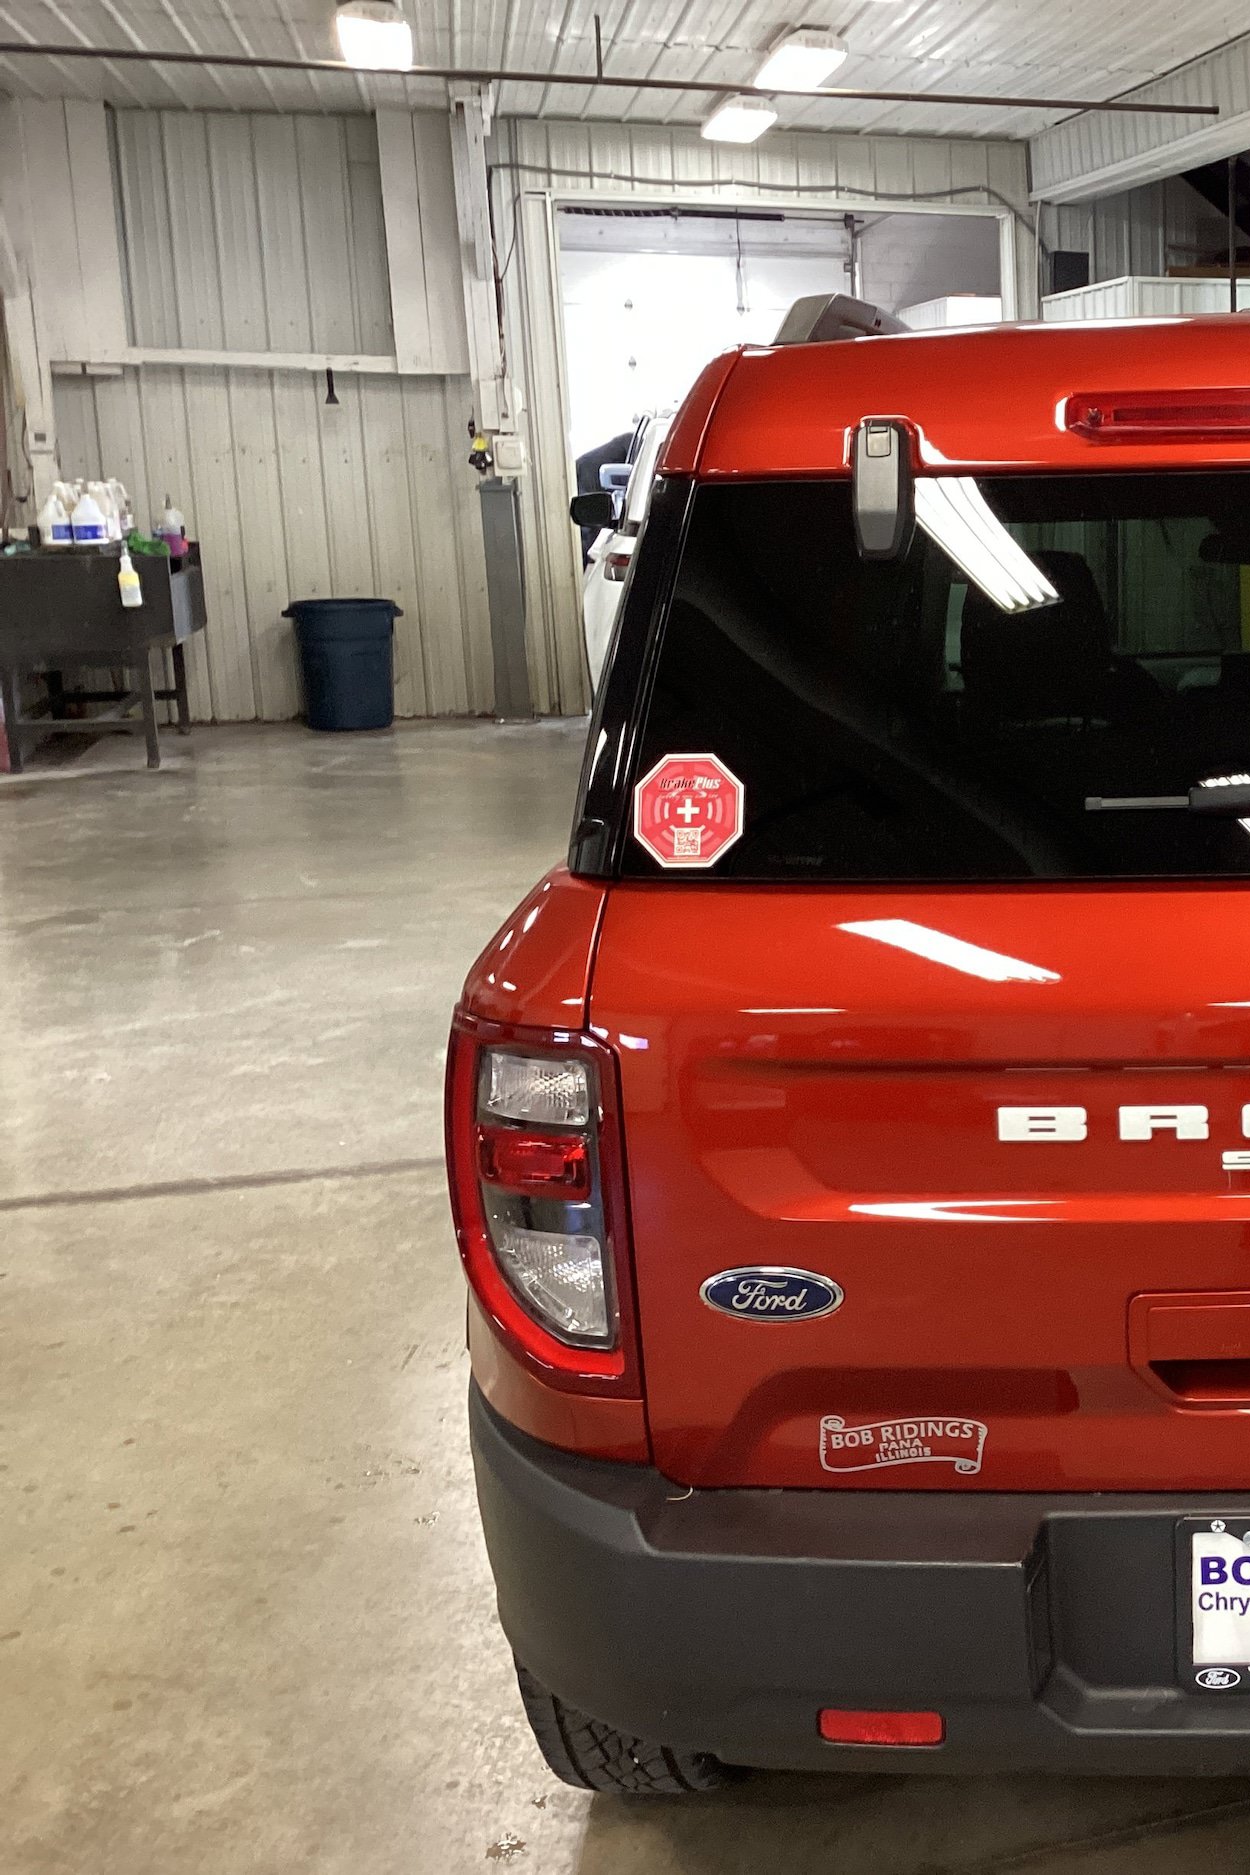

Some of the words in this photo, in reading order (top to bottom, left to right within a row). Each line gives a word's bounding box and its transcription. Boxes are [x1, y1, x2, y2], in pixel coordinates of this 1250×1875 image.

[732, 1279, 808, 1311] Ford
[831, 1429, 874, 1449] BOB
[881, 1421, 974, 1442] RIDINGS
[879, 1438, 923, 1452] PANA
[875, 1447, 932, 1462] ILLINOIS
